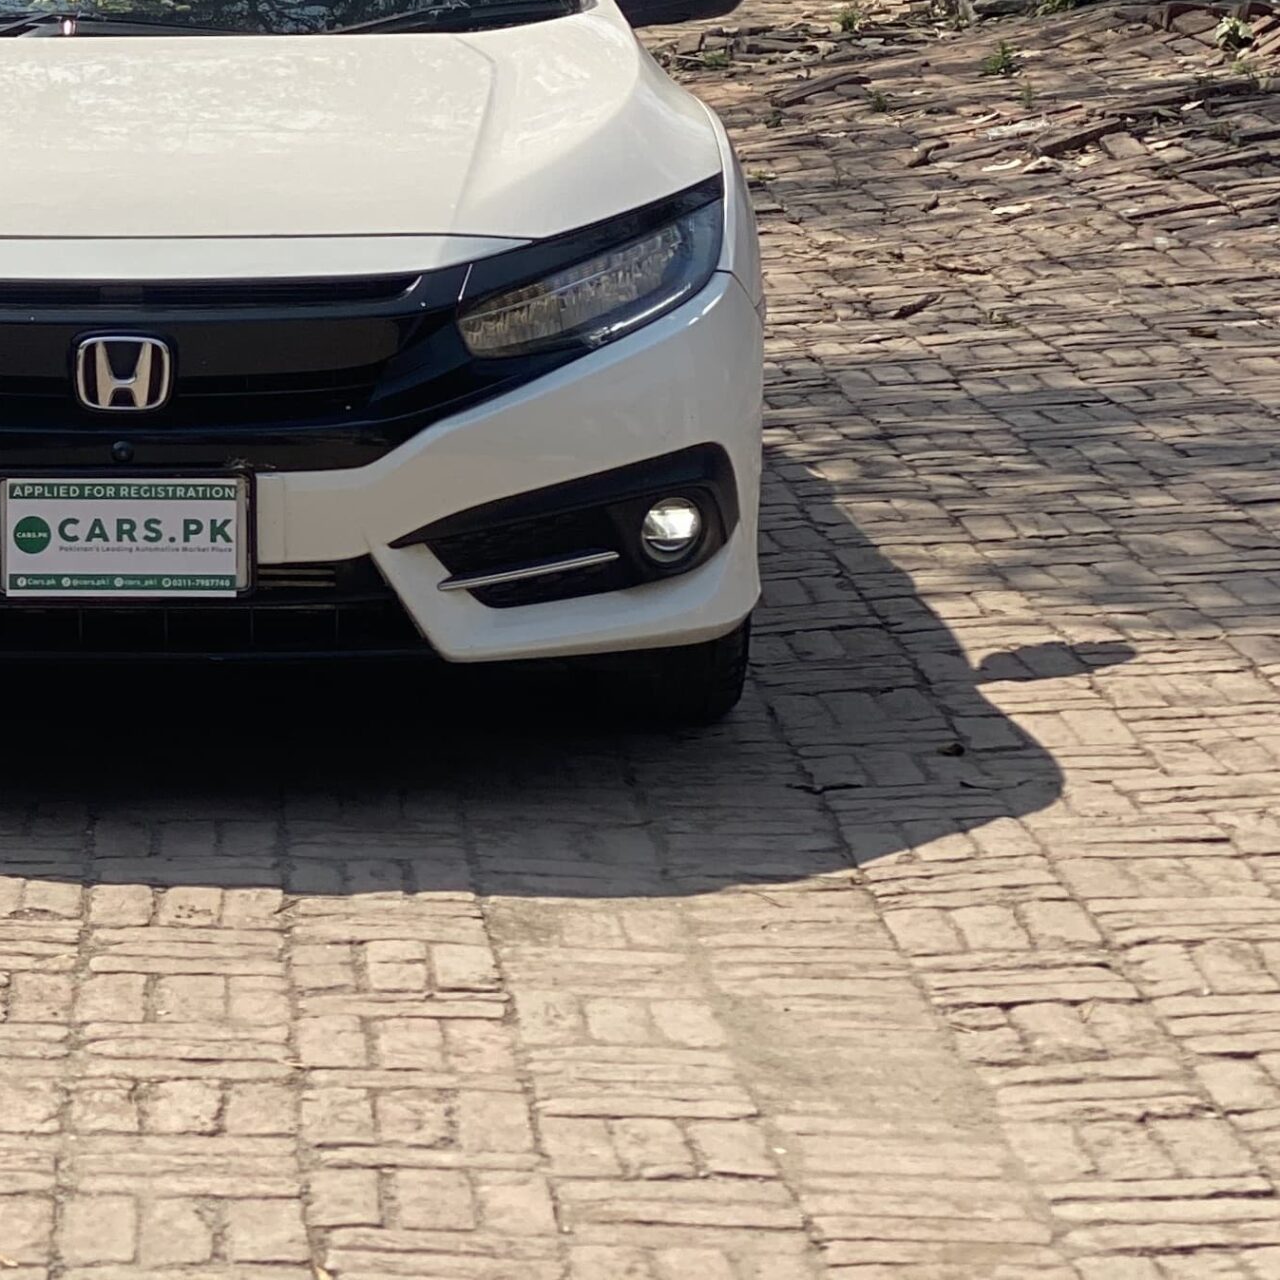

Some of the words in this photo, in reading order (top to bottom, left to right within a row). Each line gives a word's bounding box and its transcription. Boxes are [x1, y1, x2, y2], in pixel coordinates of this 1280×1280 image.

[13, 486, 80, 498] APPLIED
[84, 486, 116, 498] FOR
[121, 486, 236, 499] REGISTRATION
[16, 531, 48, 539] CARS.PK
[58, 518, 233, 543] CARS.PK
